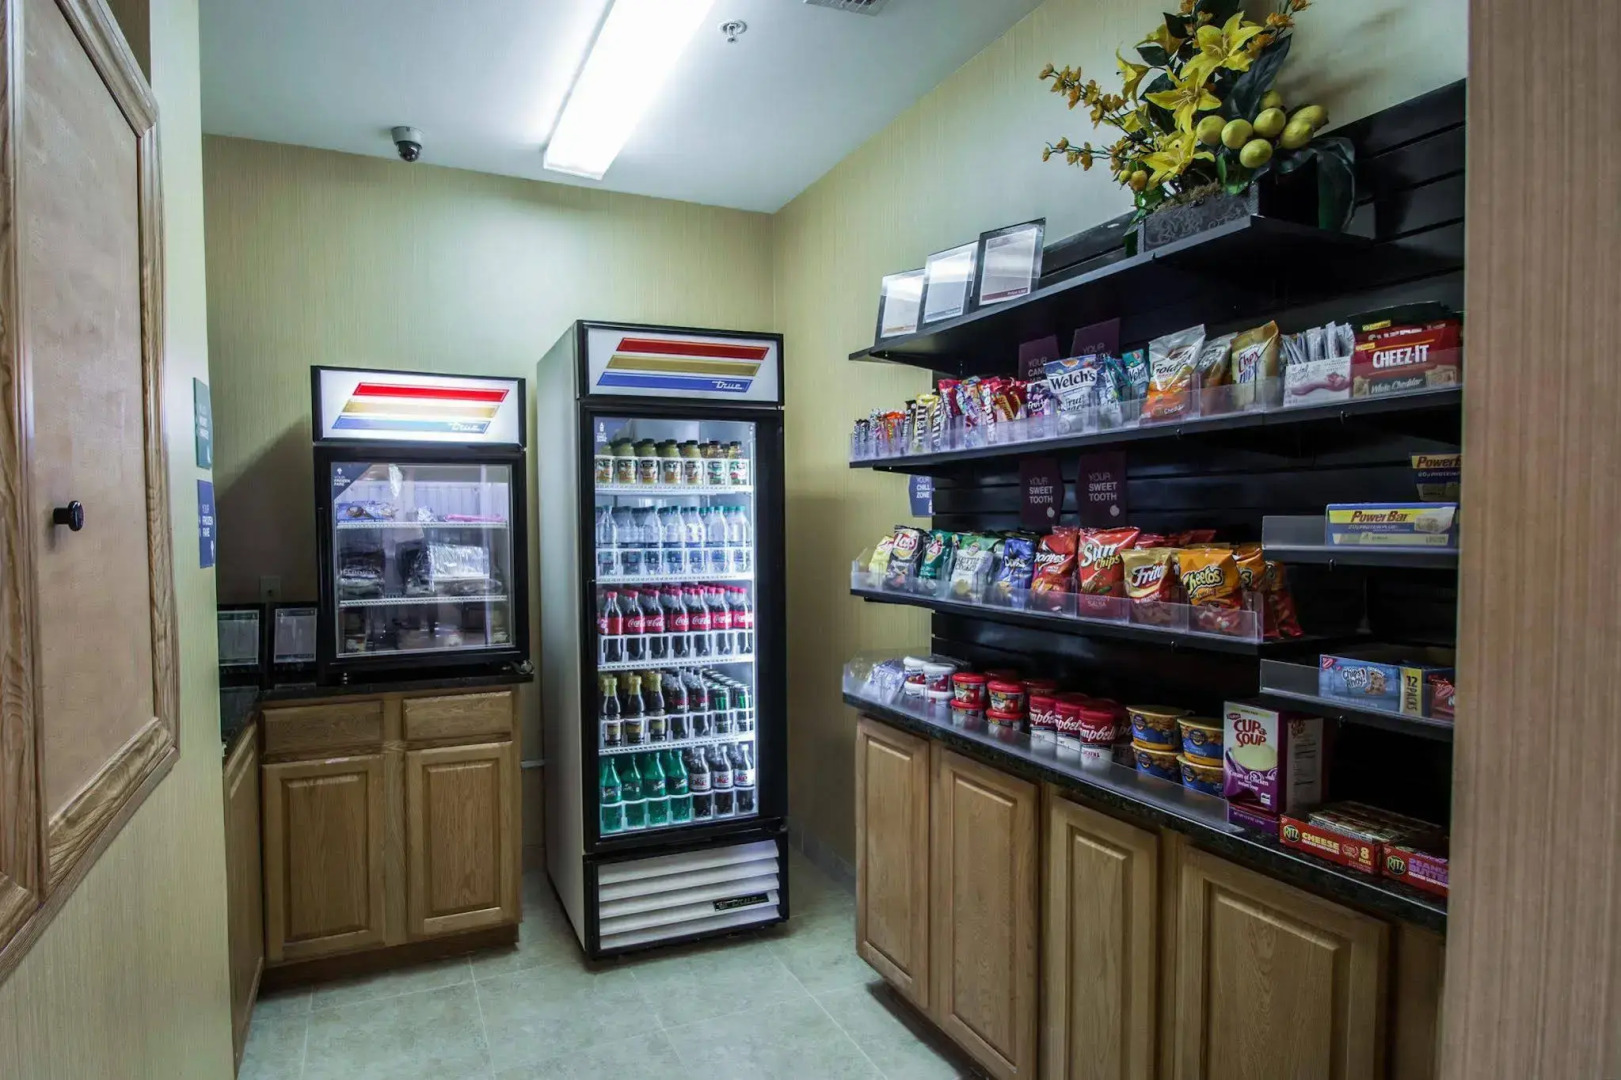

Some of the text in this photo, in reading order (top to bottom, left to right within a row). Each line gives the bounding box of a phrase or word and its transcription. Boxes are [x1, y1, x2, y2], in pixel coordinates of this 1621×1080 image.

[1082, 342, 1105, 354] YOUR
[1028, 356, 1048, 367] YOUR
[1372, 344, 1430, 368] CHEEZ-IT
[711, 380, 743, 390] True
[1049, 370, 1096, 390] Welch's
[1391, 377, 1424, 391] Cheddar
[1029, 477, 1049, 486] YOUR
[1088, 473, 1111, 482] YOUR
[1029, 486, 1054, 495] SWEET
[1088, 482, 1118, 491] SWEET
[1029, 495, 1054, 505] TOOTH
[1089, 492, 1118, 502] TOOTH
[1080, 541, 1118, 568] Sun
[1093, 555, 1121, 571] Chips
[1182, 566, 1224, 594] Cheetos
[1405, 675, 1418, 687] 12
[1405, 687, 1418, 711] PACKS
[1233, 719, 1261, 734] CUP
[1235, 732, 1267, 748] SOUP
[1283, 826, 1300, 840] RITZ
[1301, 832, 1340, 851] CHEESE
[1360, 847, 1370, 860] 8
[1387, 856, 1405, 871] RITZ
[1408, 857, 1449, 875] PEANU
